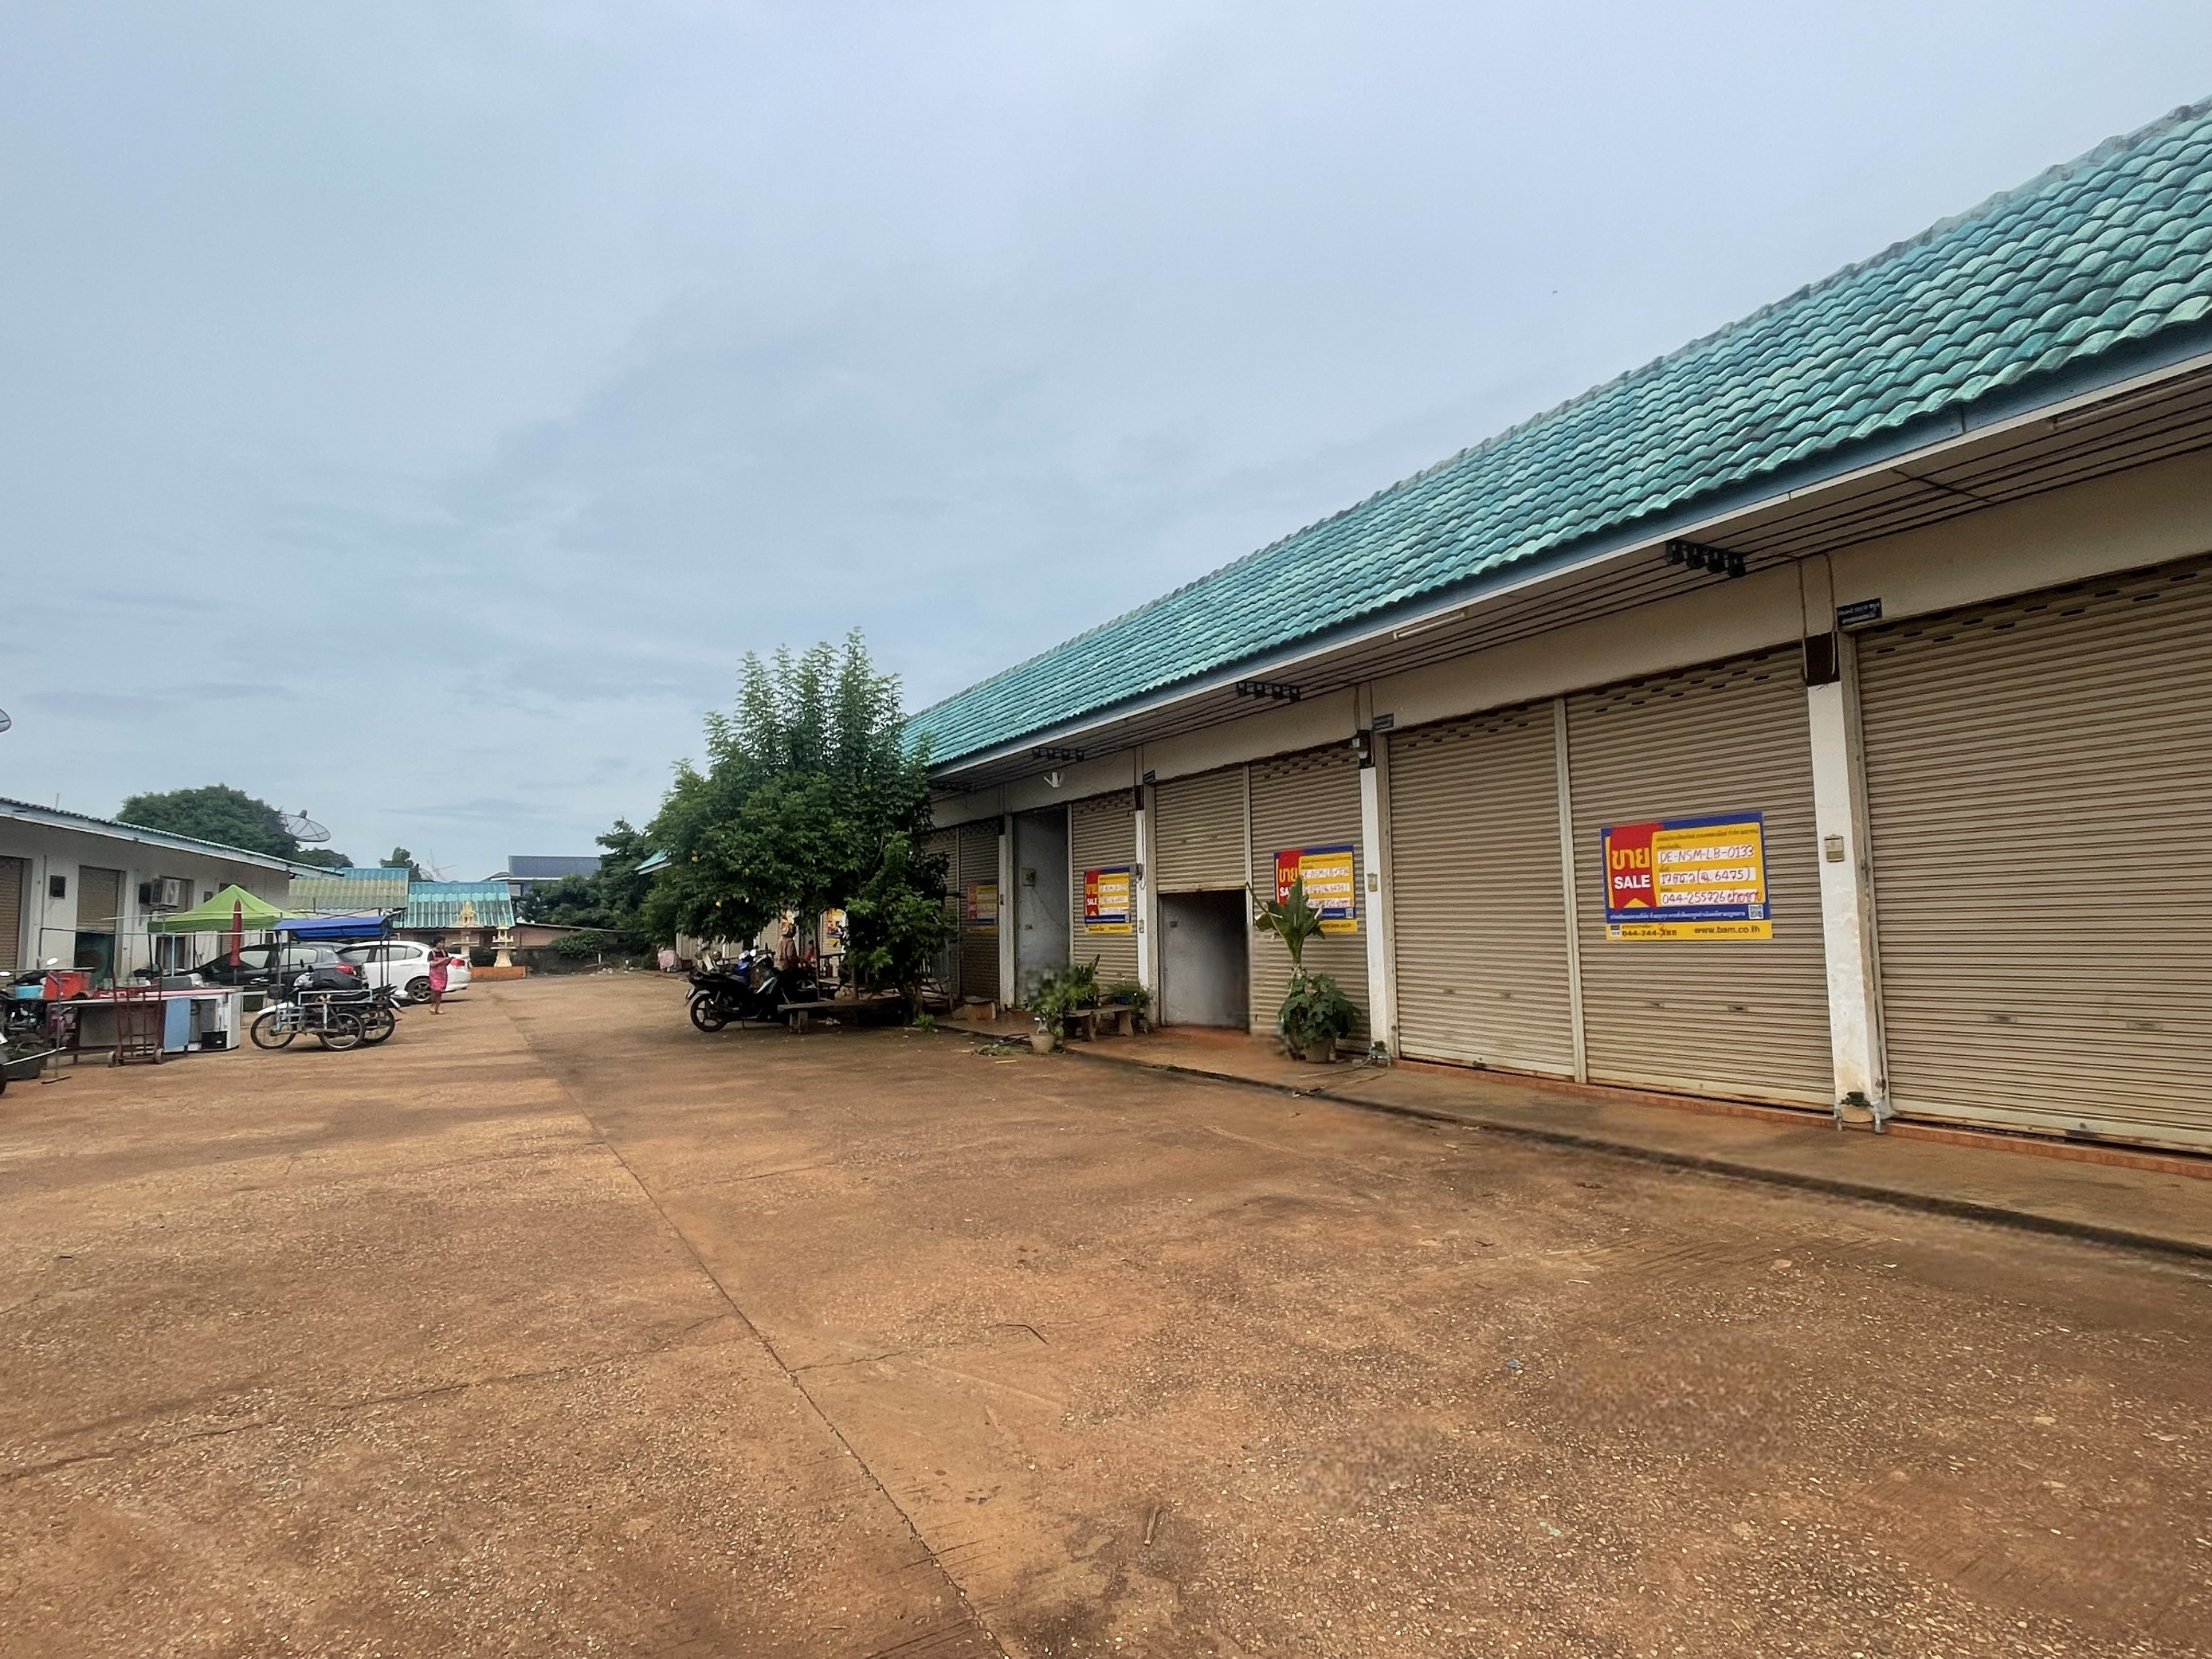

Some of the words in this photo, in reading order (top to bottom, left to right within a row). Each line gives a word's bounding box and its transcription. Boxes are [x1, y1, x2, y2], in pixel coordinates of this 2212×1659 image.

[1611, 847, 1650, 870] ขาย
[1614, 873, 1651, 890] SALE
[1694, 925, 1760, 934] www.bam.co.th
